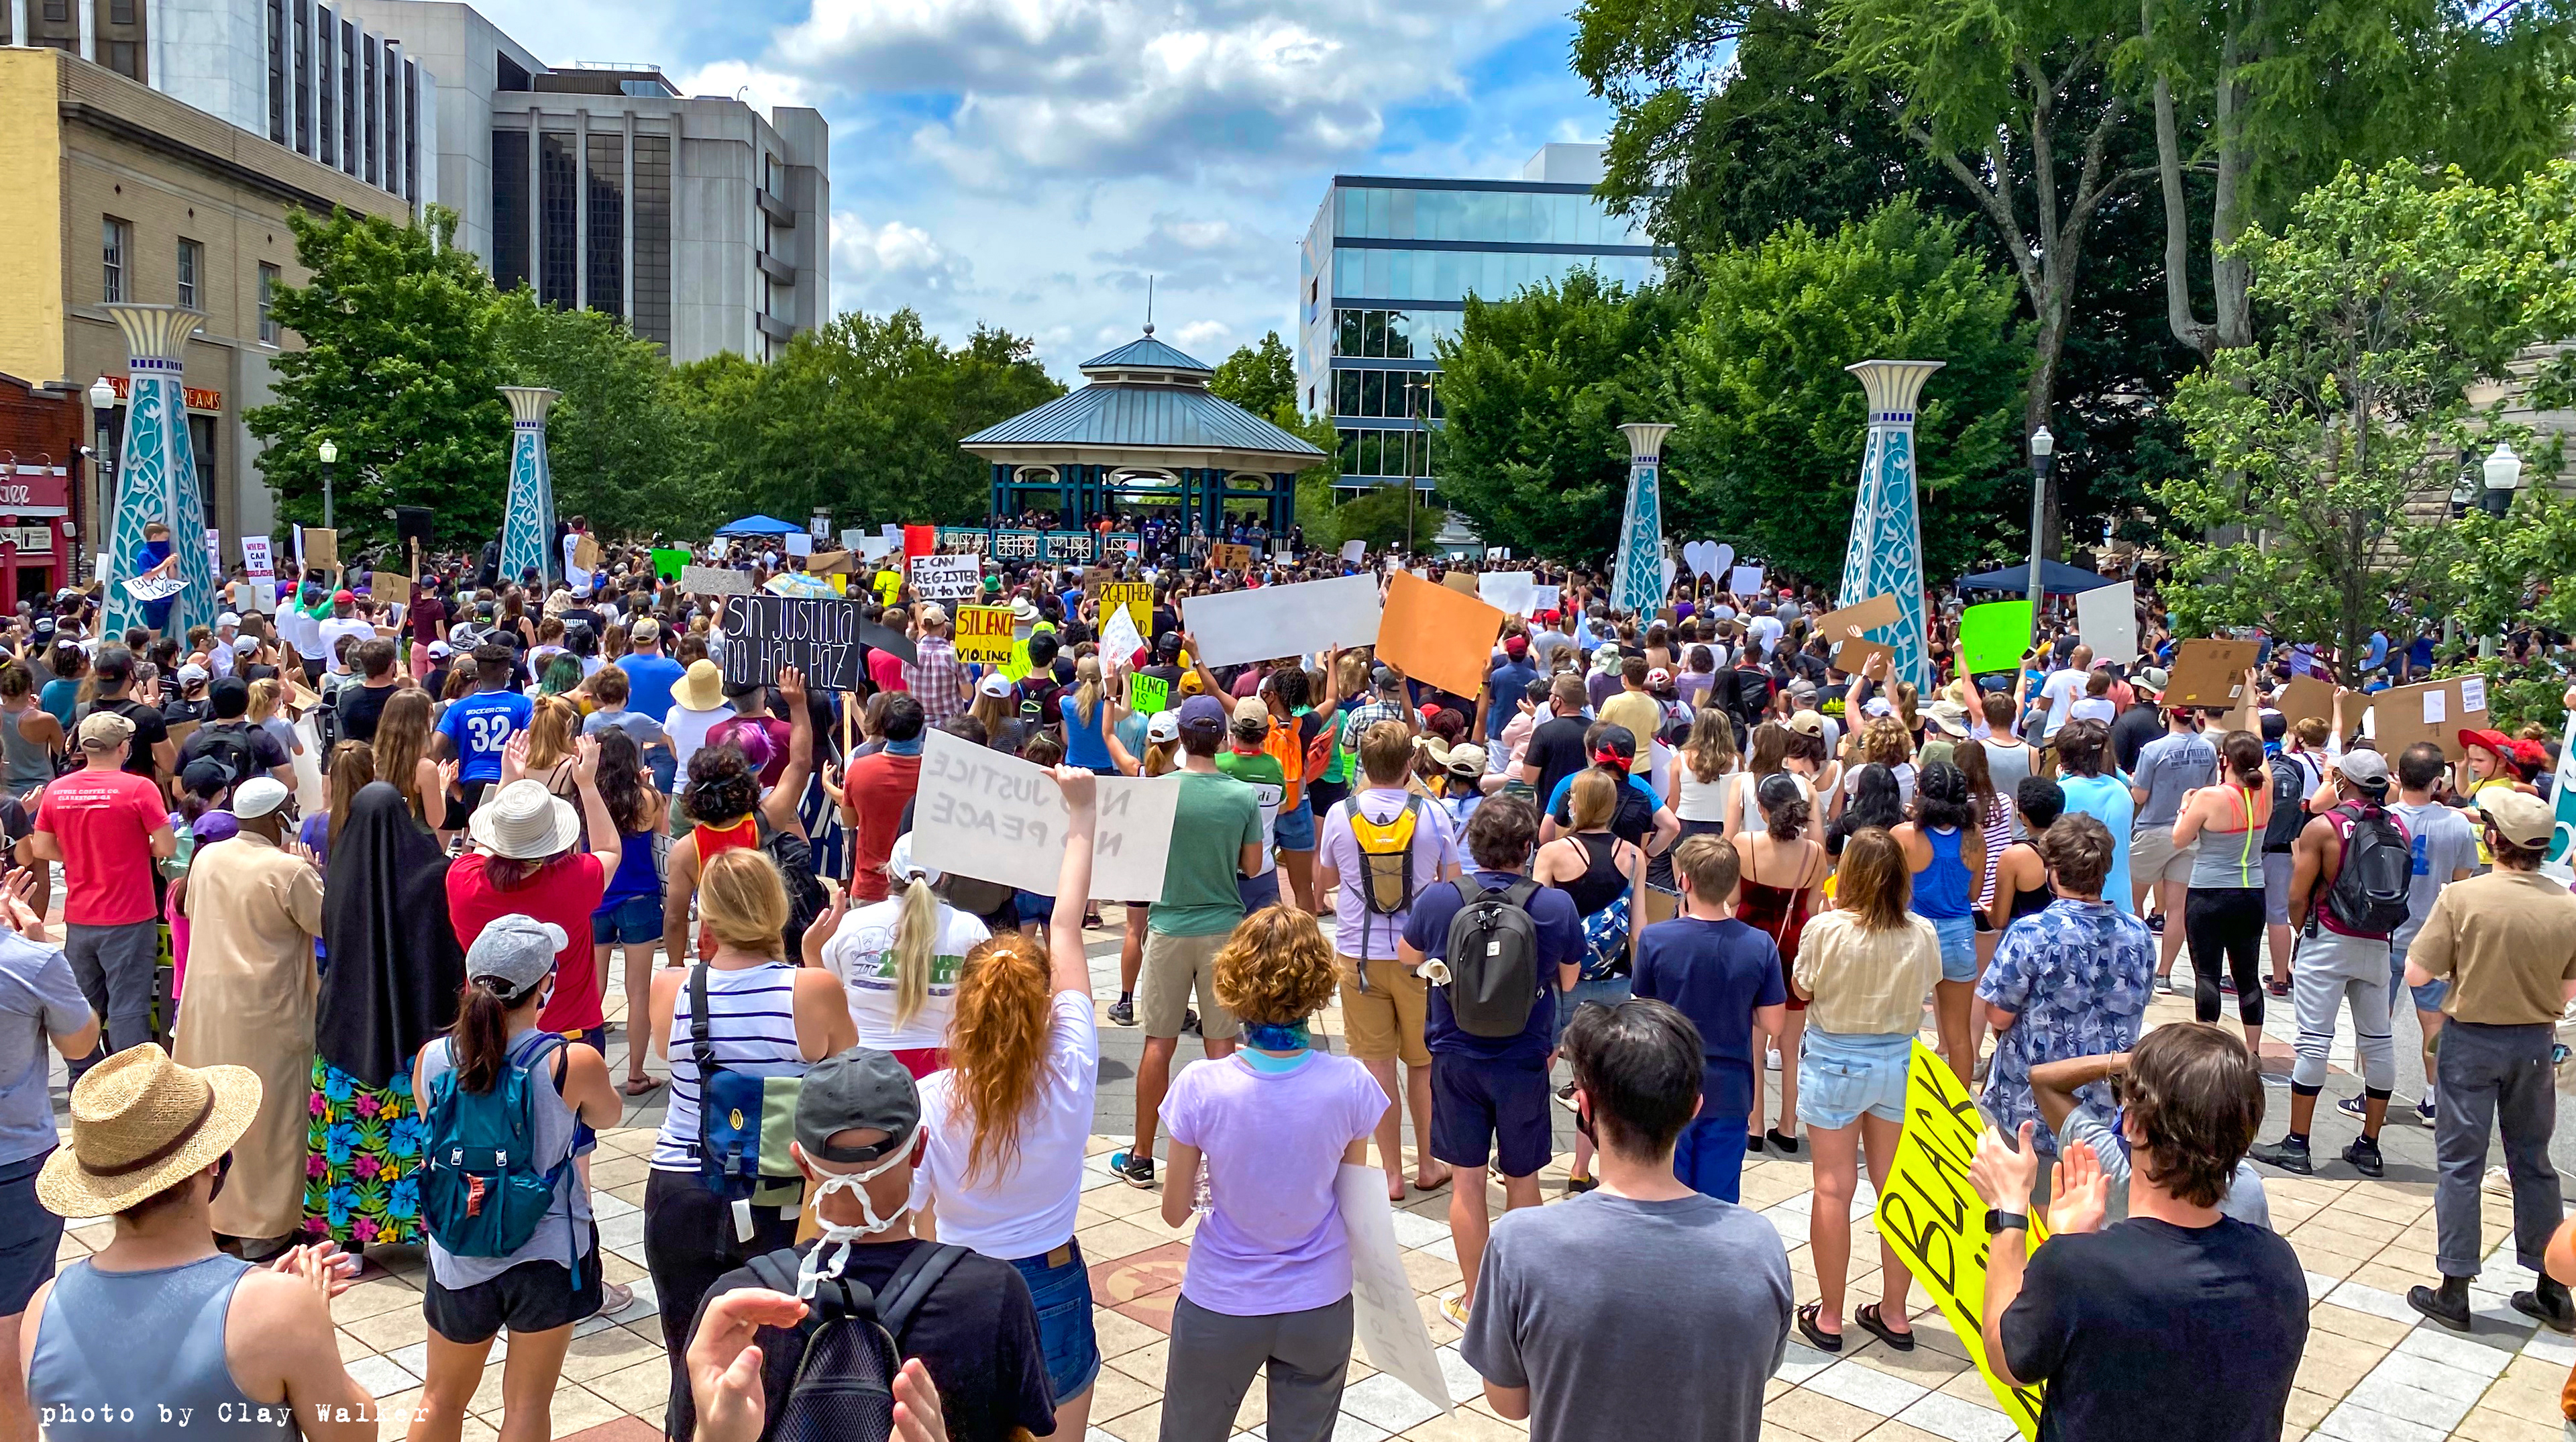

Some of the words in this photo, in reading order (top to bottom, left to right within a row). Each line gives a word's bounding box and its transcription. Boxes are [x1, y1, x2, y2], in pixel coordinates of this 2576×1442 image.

[183, 389, 219, 409] REAMS
[913, 558, 924, 569] I
[930, 557, 955, 567] CAN
[914, 570, 979, 584] REGISTER
[938, 585, 953, 596] to
[957, 584, 976, 595] VOT
[957, 611, 1014, 636] SILENCE
[979, 636, 991, 648] IS
[957, 648, 1011, 663] VIOLENCE
[1136, 692, 1148, 705] IS
[468, 715, 510, 752] 32
[1882, 1055, 1978, 1296] BLACK
